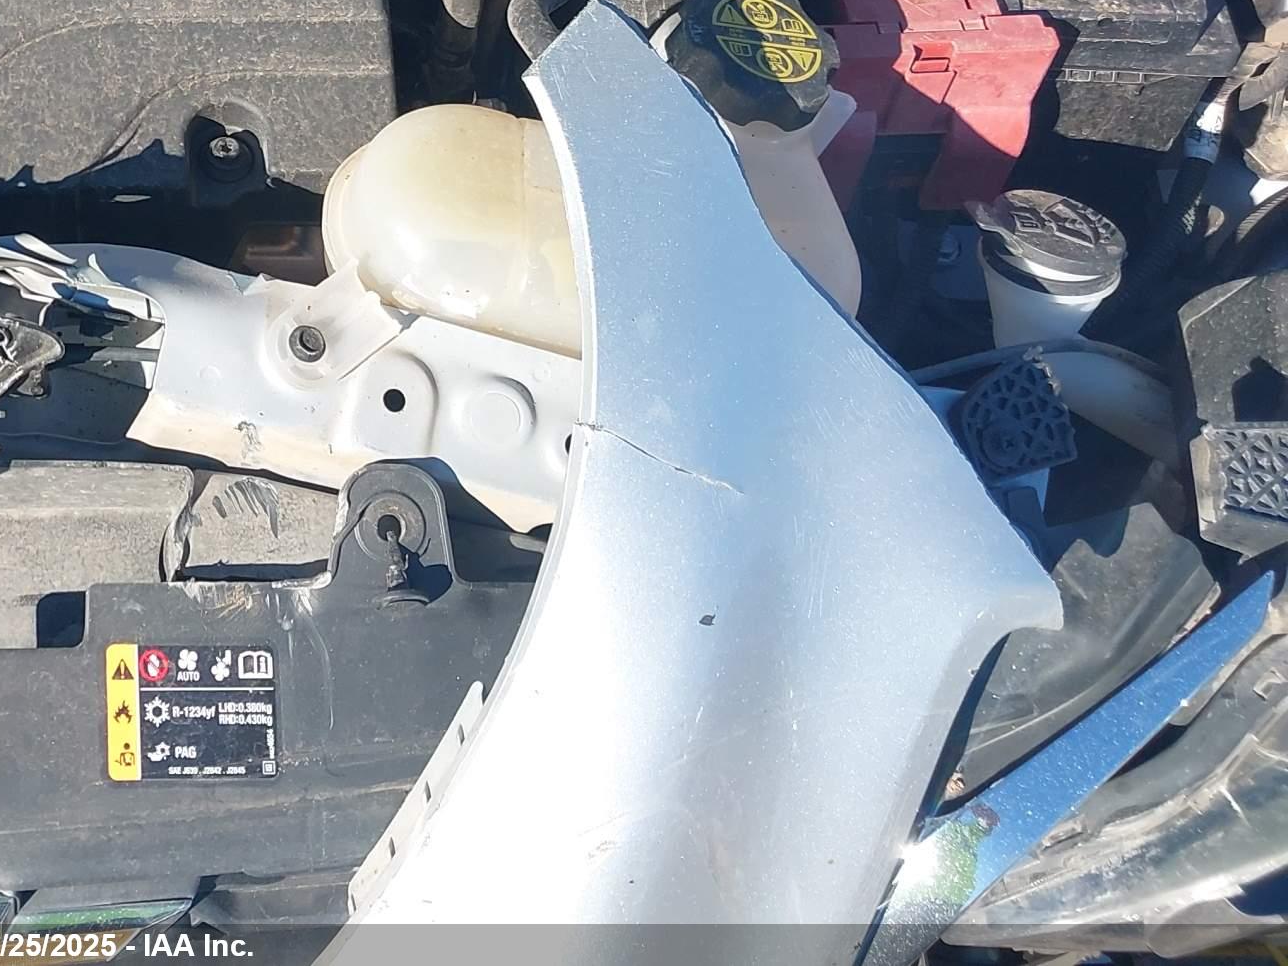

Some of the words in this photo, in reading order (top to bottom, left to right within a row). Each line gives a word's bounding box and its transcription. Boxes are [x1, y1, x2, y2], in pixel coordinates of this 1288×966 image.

[177, 671, 200, 682] AUTO
[172, 705, 216, 720] R-1234yf
[174, 745, 197, 759] PAG
